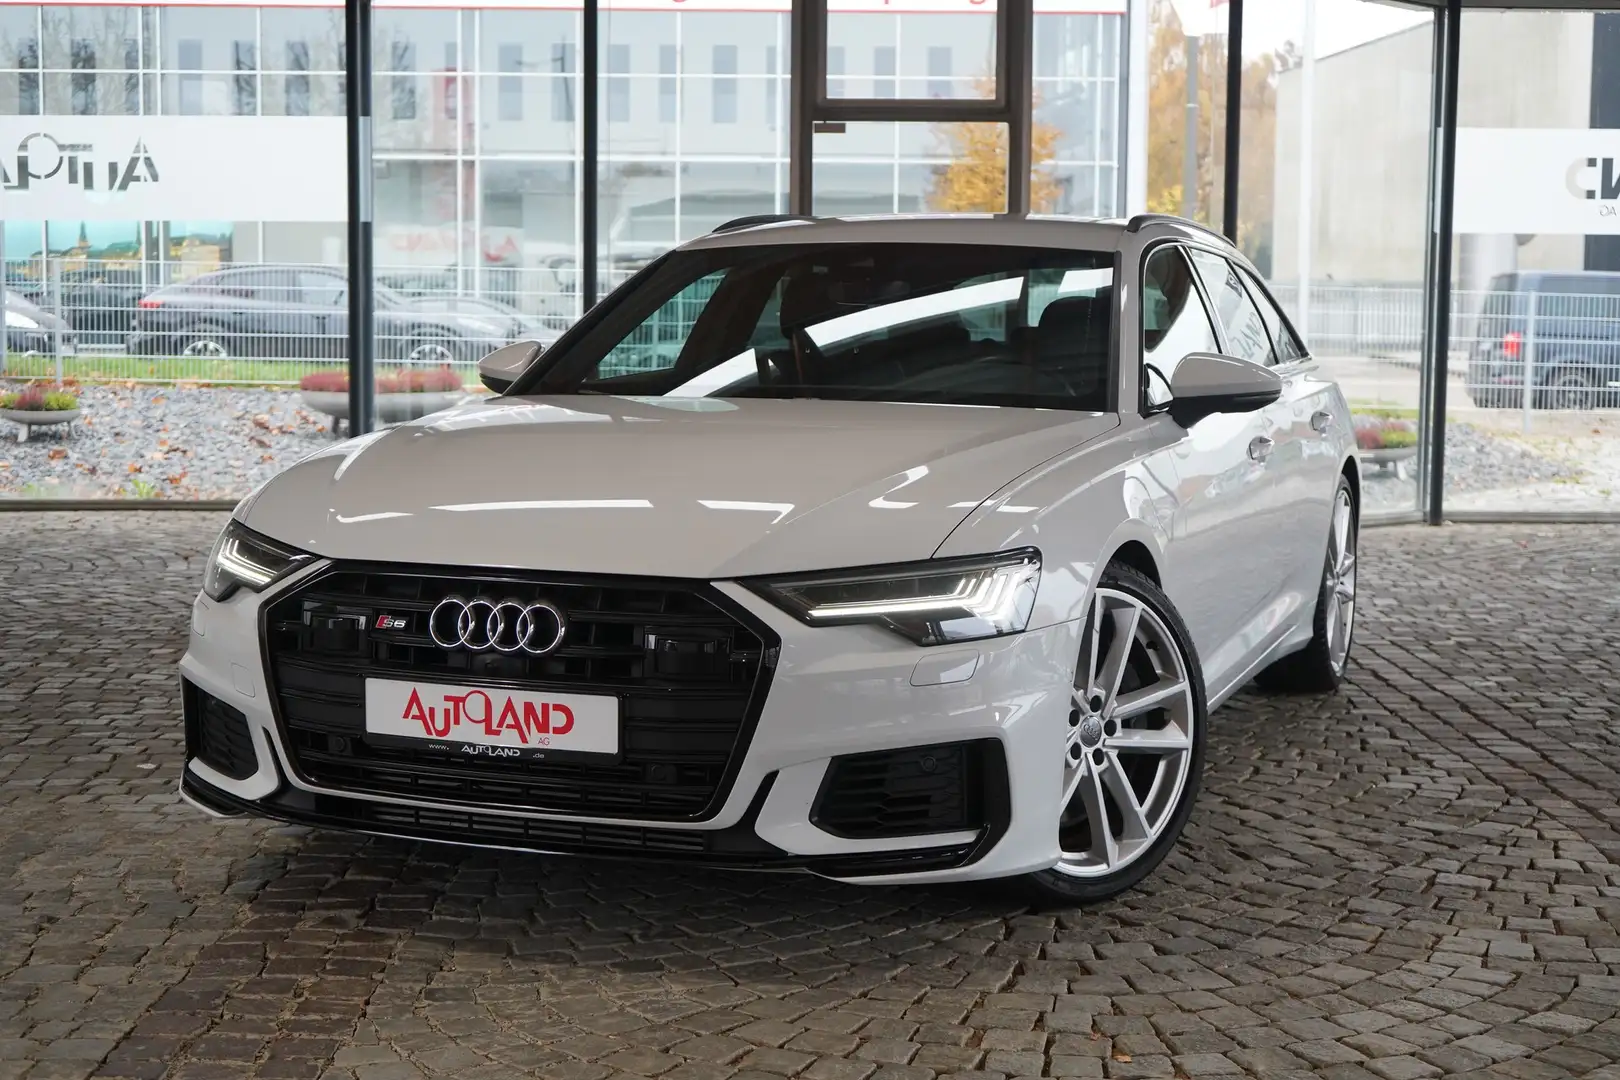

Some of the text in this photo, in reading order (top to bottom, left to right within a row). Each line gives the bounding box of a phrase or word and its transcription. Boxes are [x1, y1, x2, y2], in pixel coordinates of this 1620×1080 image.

[380, 617, 406, 628] S6
[402, 686, 575, 745] AUTOLAND
[537, 737, 550, 746] AG
[428, 743, 450, 751] www.
[461, 744, 521, 758] AUTOLAND
